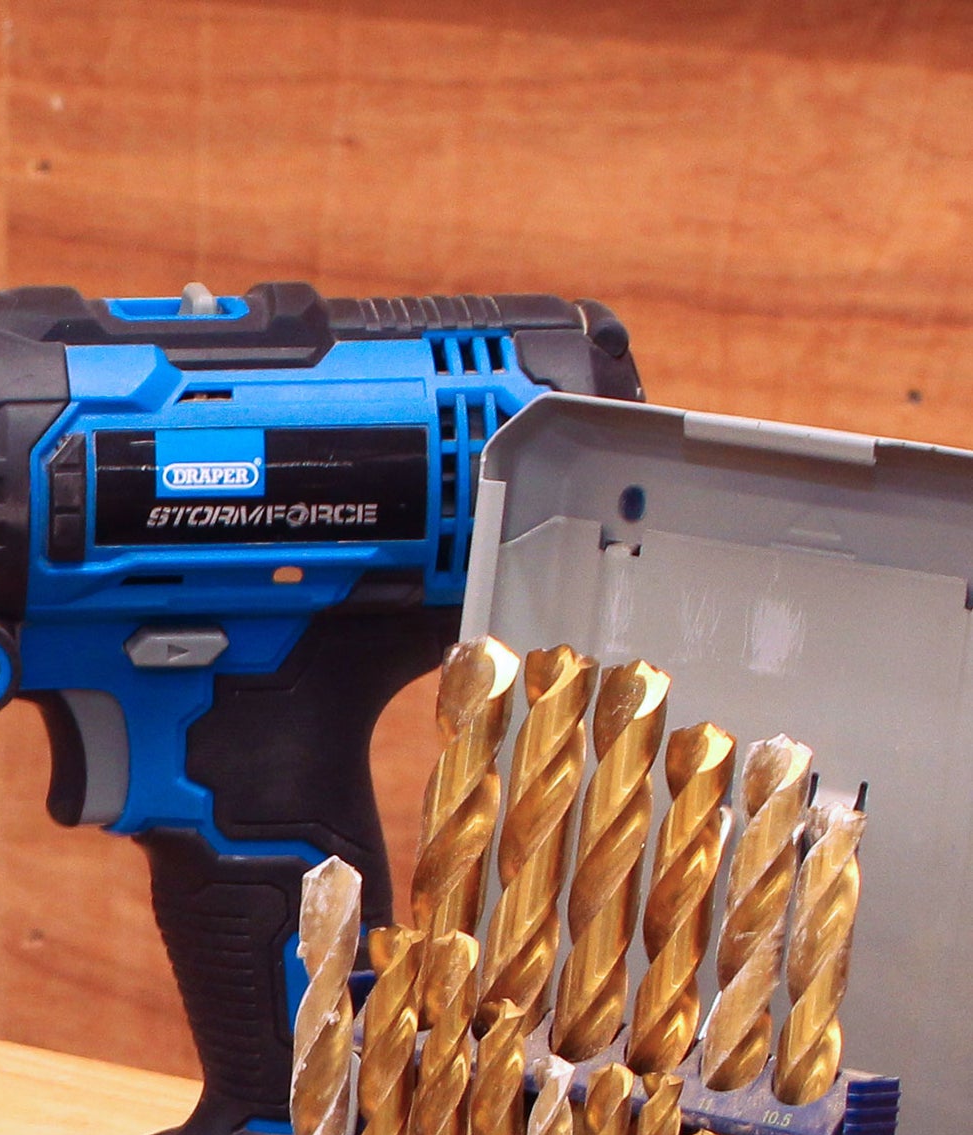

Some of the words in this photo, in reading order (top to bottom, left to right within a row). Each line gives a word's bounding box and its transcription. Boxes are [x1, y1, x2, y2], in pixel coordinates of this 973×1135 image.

[172, 464, 250, 487] DRAPER
[146, 503, 378, 529] STORMFORCE
[761, 1110, 792, 1128] 10.5
